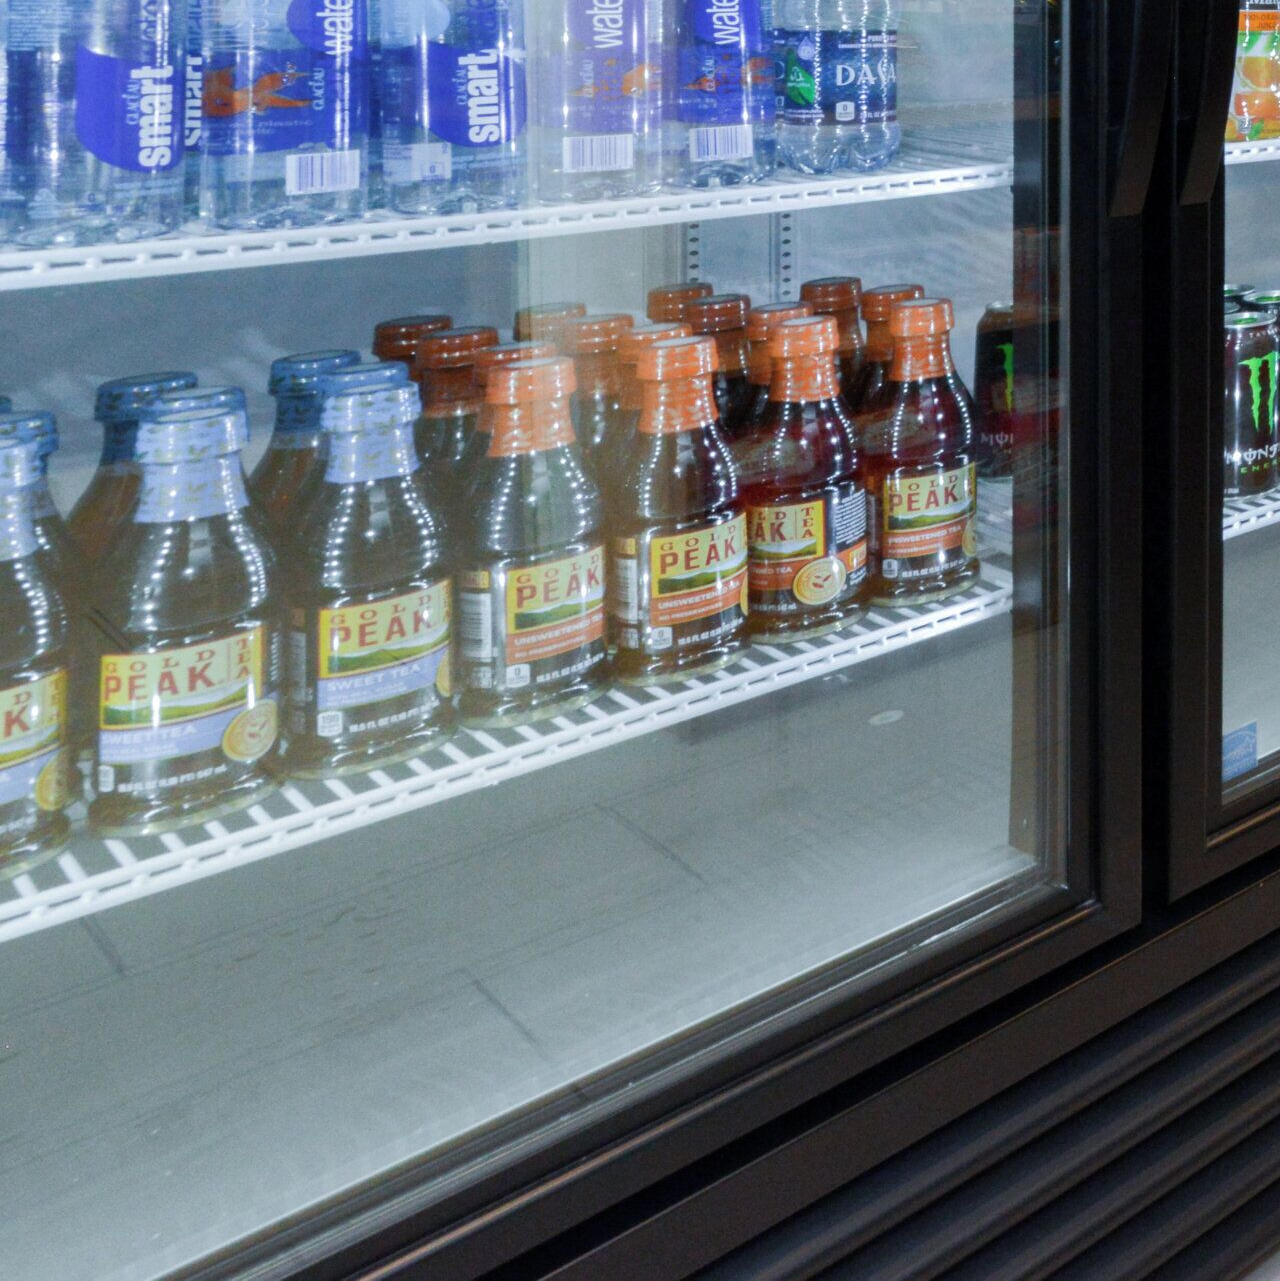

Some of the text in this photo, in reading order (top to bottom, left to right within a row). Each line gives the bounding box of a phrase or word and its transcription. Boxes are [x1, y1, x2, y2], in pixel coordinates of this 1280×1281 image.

[458, 48, 501, 143] smart
[131, 65, 173, 168] smart
[889, 484, 959, 512] PEAK
[660, 524, 737, 552] GOLD
[660, 536, 737, 575] PEAK
[516, 566, 600, 609] PEAK
[330, 596, 433, 626] GOLD
[330, 611, 432, 648] PEAK
[104, 662, 216, 701] PEAK
[391, 663, 421, 679] TEA
